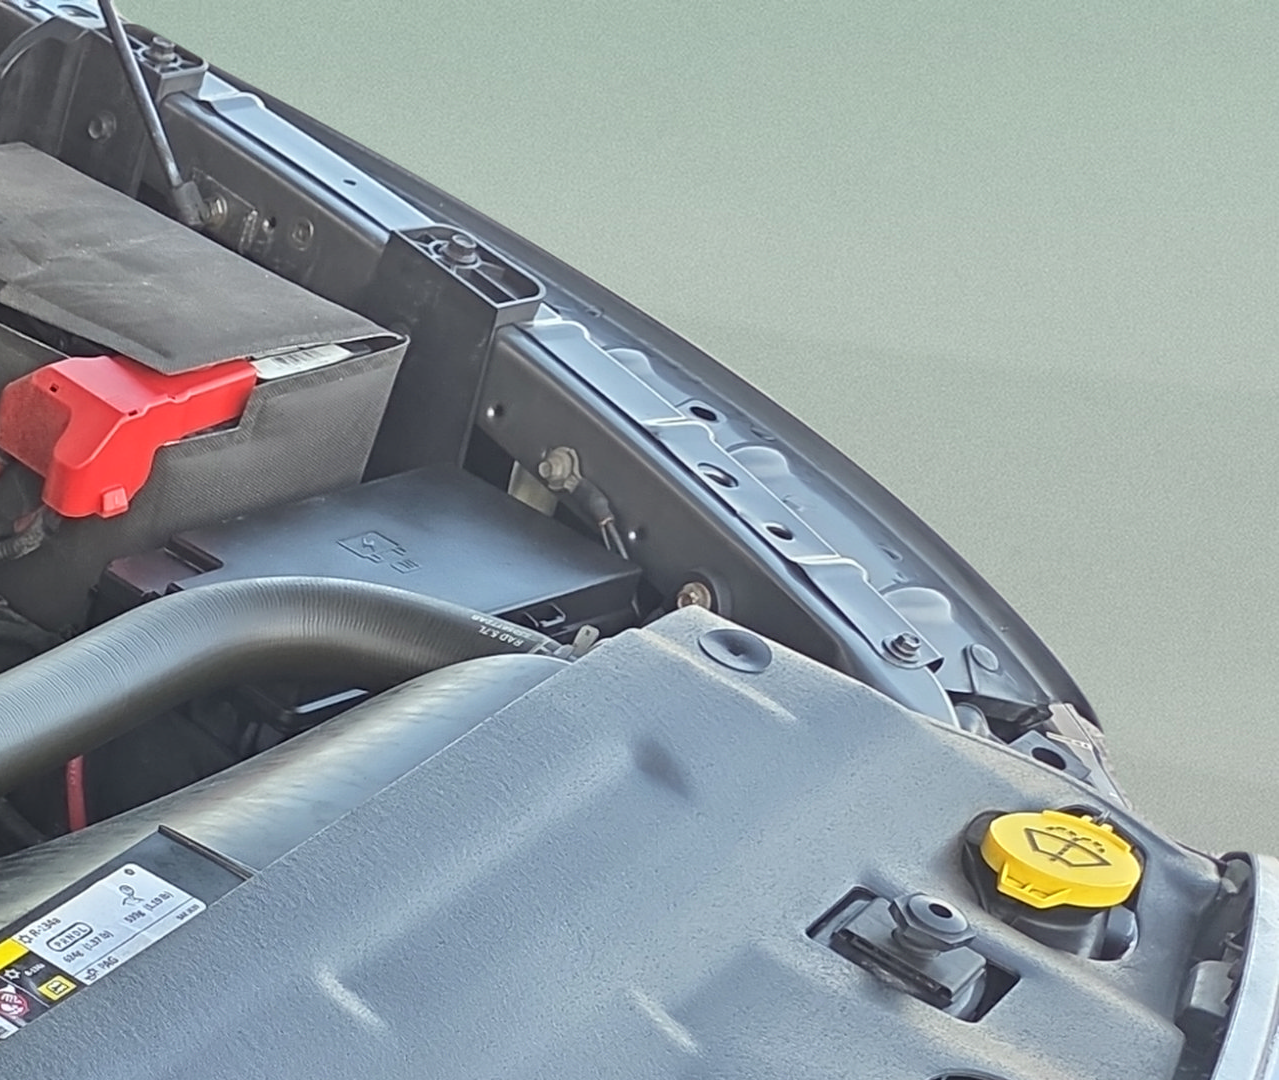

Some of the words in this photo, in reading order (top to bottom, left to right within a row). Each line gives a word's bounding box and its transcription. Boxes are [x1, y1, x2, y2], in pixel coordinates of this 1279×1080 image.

[499, 632, 524, 647] RAD
[29, 917, 61, 937] R-134a
[54, 926, 88, 948] PRNDL
[99, 956, 120, 970] PAG
